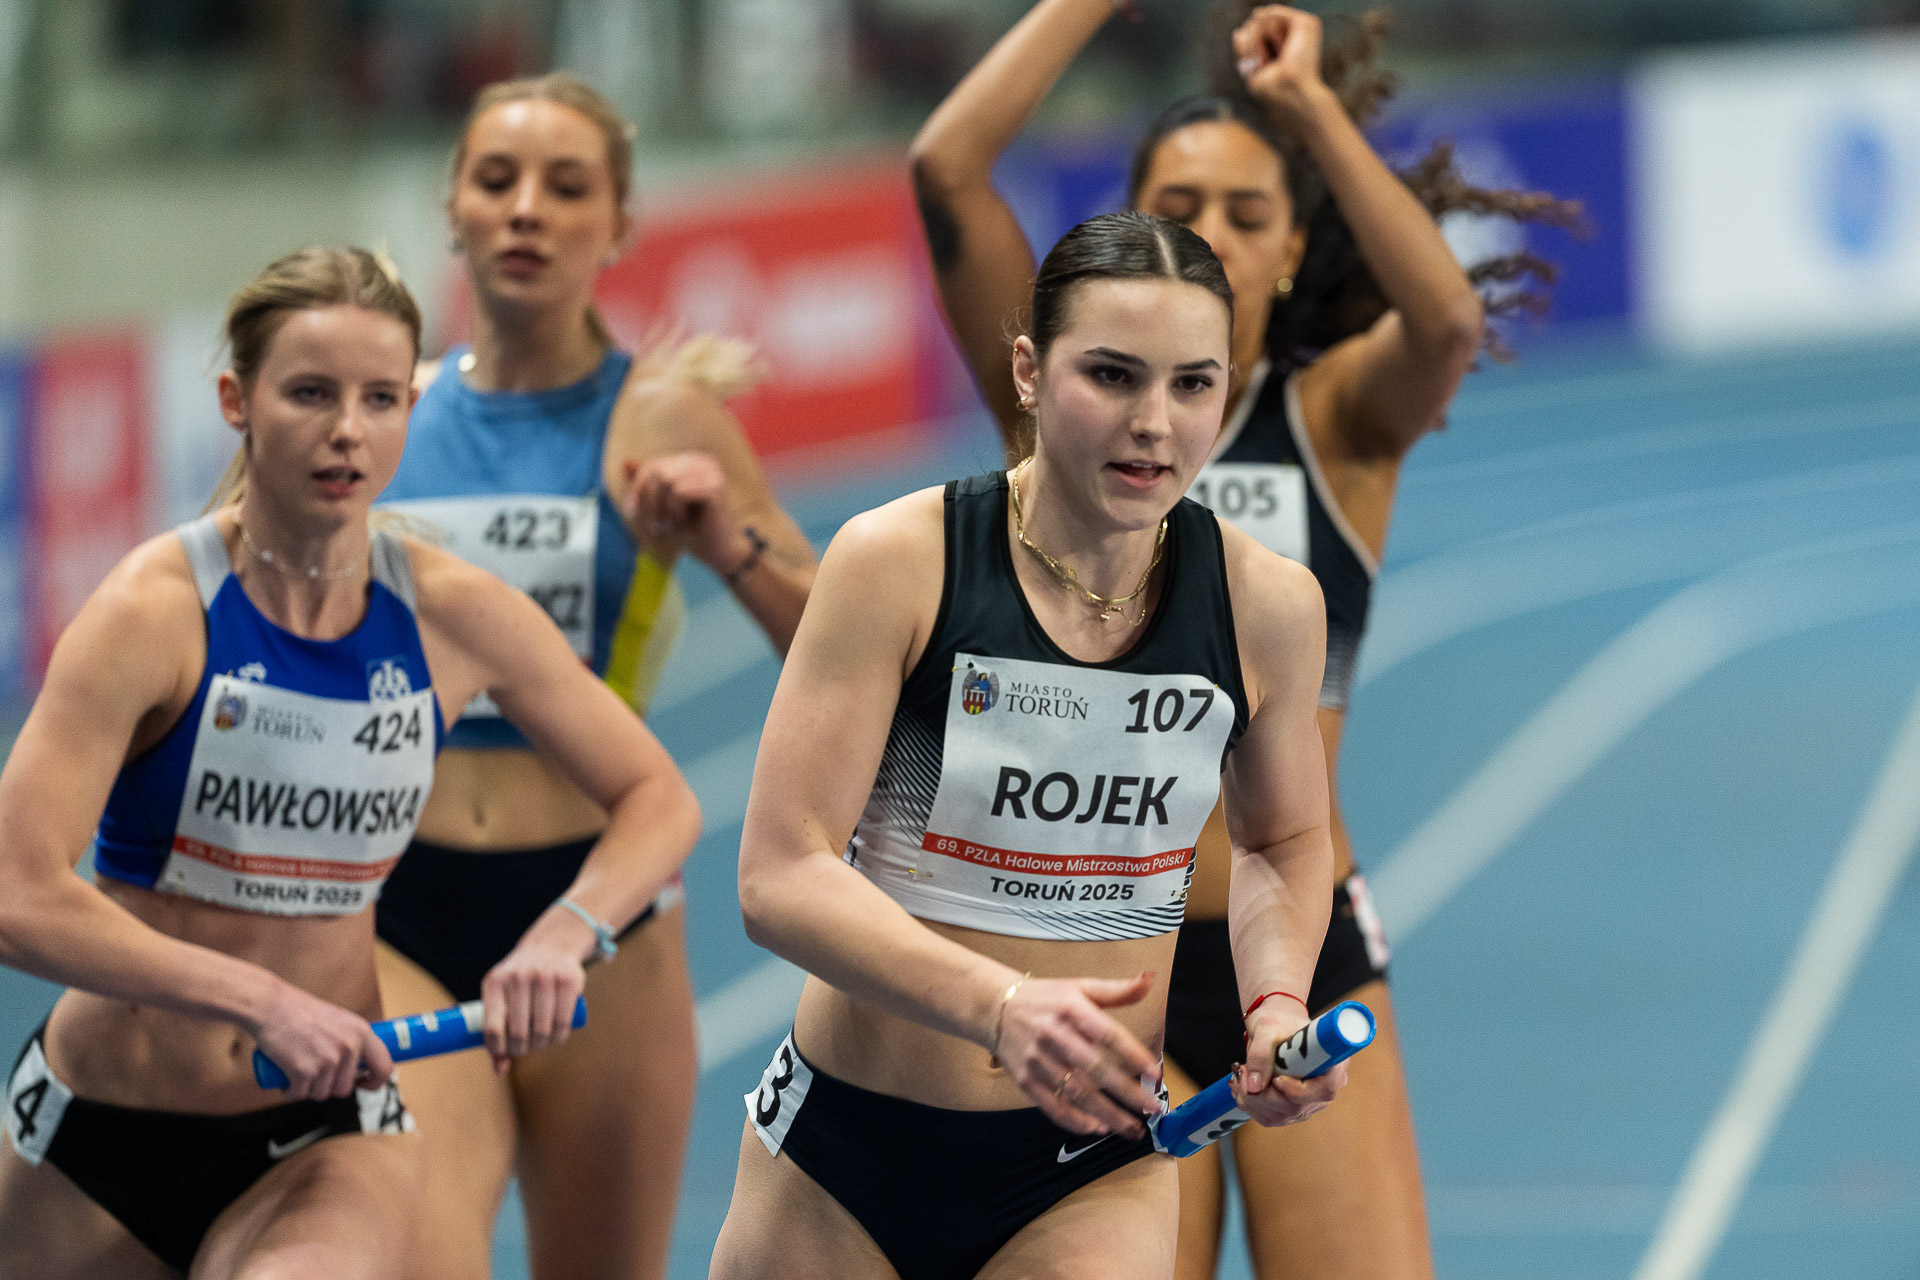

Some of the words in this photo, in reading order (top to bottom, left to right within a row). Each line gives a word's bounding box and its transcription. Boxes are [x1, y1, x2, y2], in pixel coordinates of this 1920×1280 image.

[1195, 477, 1278, 519] 105
[483, 507, 570, 549] 423
[1004, 692, 1090, 721] TORUŃ
[1010, 681, 1072, 698] MIASTO
[1125, 688, 1215, 733] 107
[353, 704, 422, 754] 424
[195, 770, 421, 835] PAWŁOWSKA
[988, 765, 1179, 826] ROJEK
[936, 838, 960, 855] 69.
[964, 845, 1001, 865] PZLA
[1004, 854, 1064, 872] Halowe
[1065, 858, 1151, 873] Mistrzostwa
[1152, 851, 1186, 871] Polski
[990, 876, 1076, 901] TORUŃ
[1078, 883, 1135, 901] 2025
[756, 1045, 793, 1128] 3
[14, 1077, 49, 1142] 4
